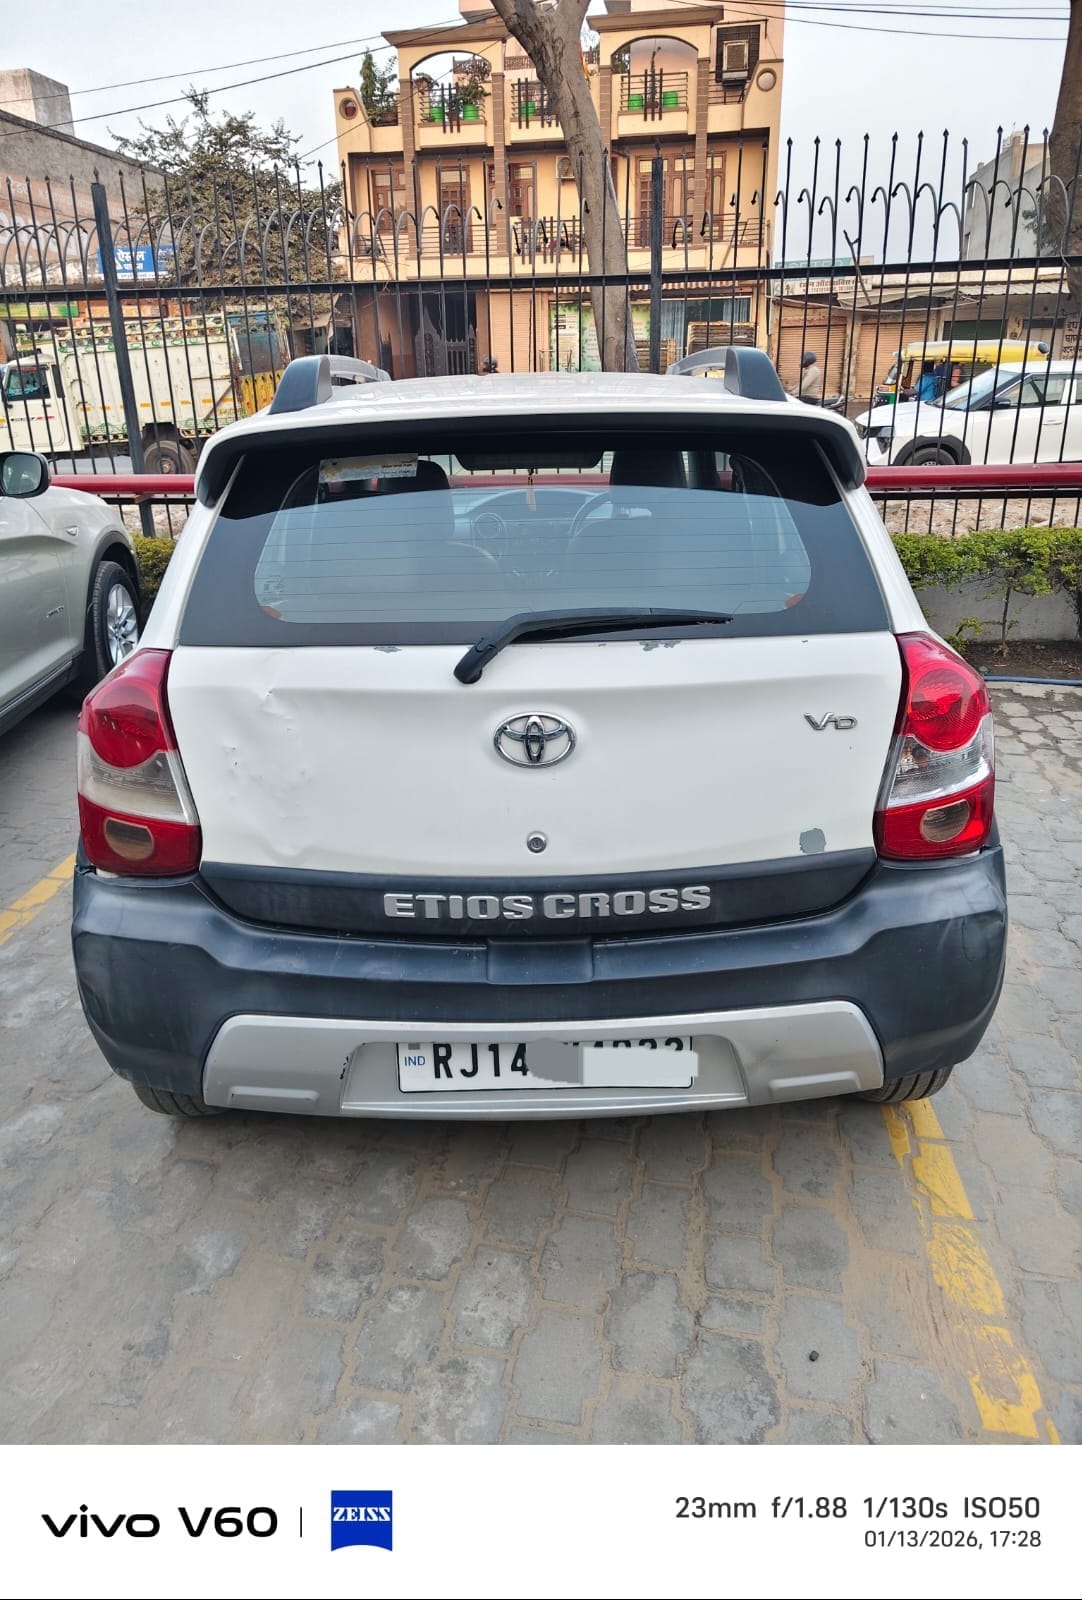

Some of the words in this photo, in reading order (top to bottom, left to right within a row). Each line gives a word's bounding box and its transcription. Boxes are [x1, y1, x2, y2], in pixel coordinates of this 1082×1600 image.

[384, 893, 534, 920] ETIOS
[543, 885, 711, 919] CROSS
[404, 1055, 426, 1067] IND
